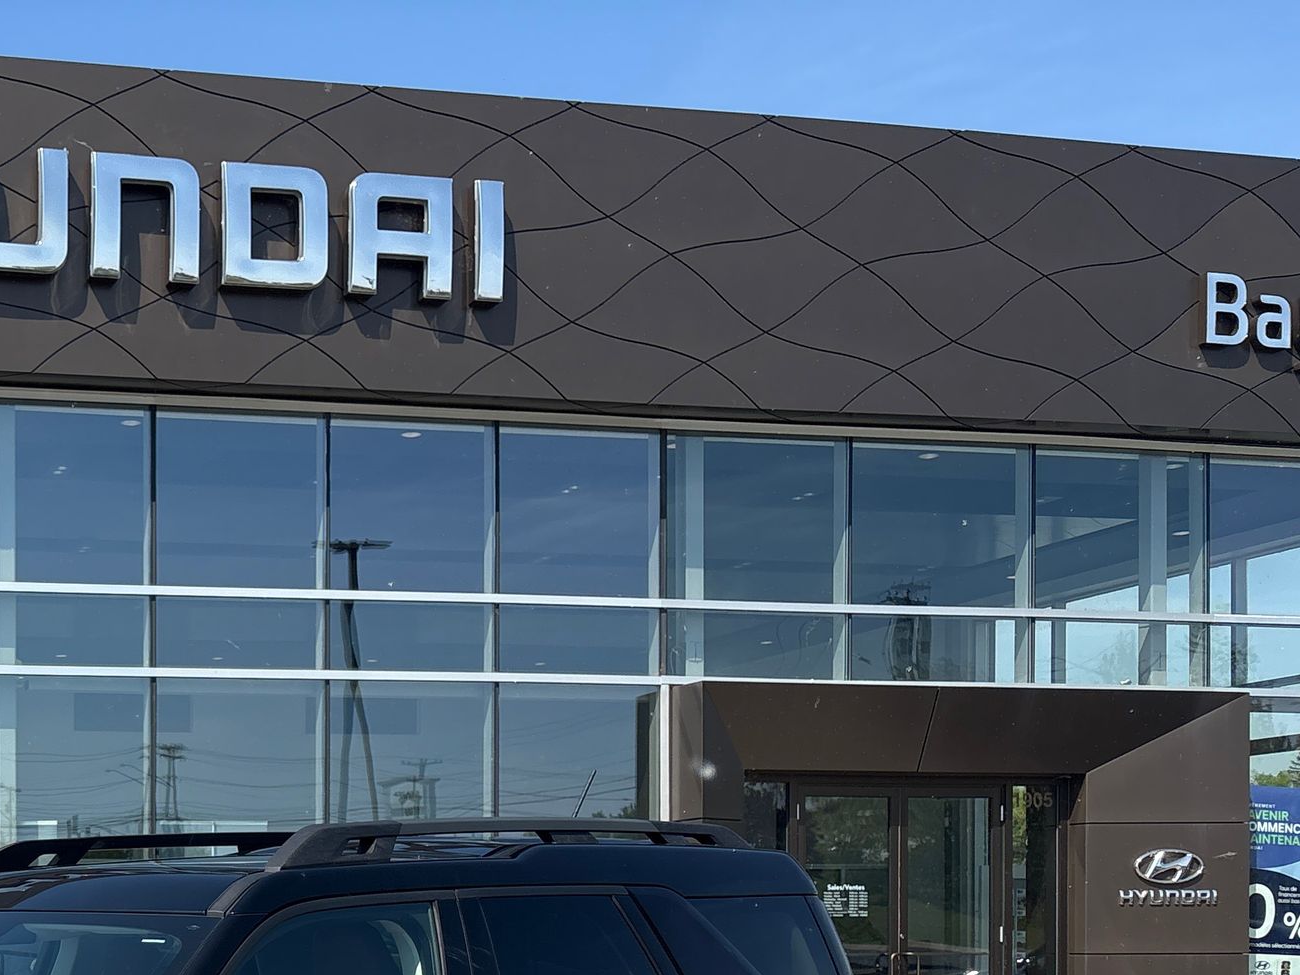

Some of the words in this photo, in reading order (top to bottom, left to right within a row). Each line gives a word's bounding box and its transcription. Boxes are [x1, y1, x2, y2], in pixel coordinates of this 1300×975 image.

[1206, 271, 1292, 349] Ba
[827, 883, 865, 891] Sales/Ventes
[1118, 889, 1218, 909] HYUNDAI
